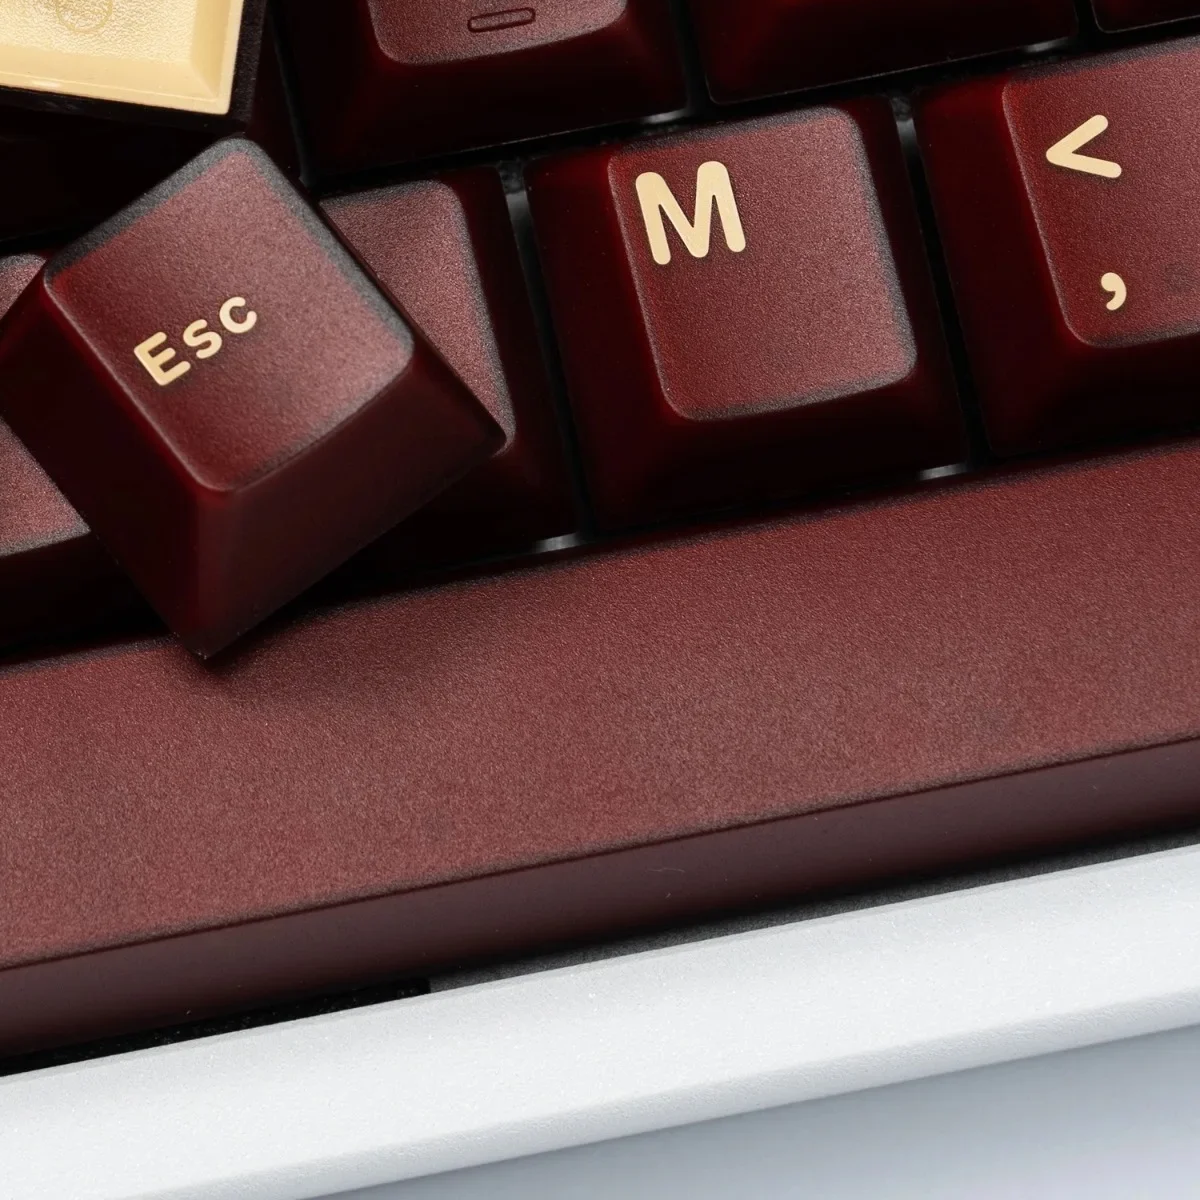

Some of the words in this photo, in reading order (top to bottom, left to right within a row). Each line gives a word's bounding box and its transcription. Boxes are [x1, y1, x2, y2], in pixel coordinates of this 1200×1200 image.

[1044, 114, 1123, 180] <
[634, 159, 748, 266] M
[132, 295, 260, 387] Esc
